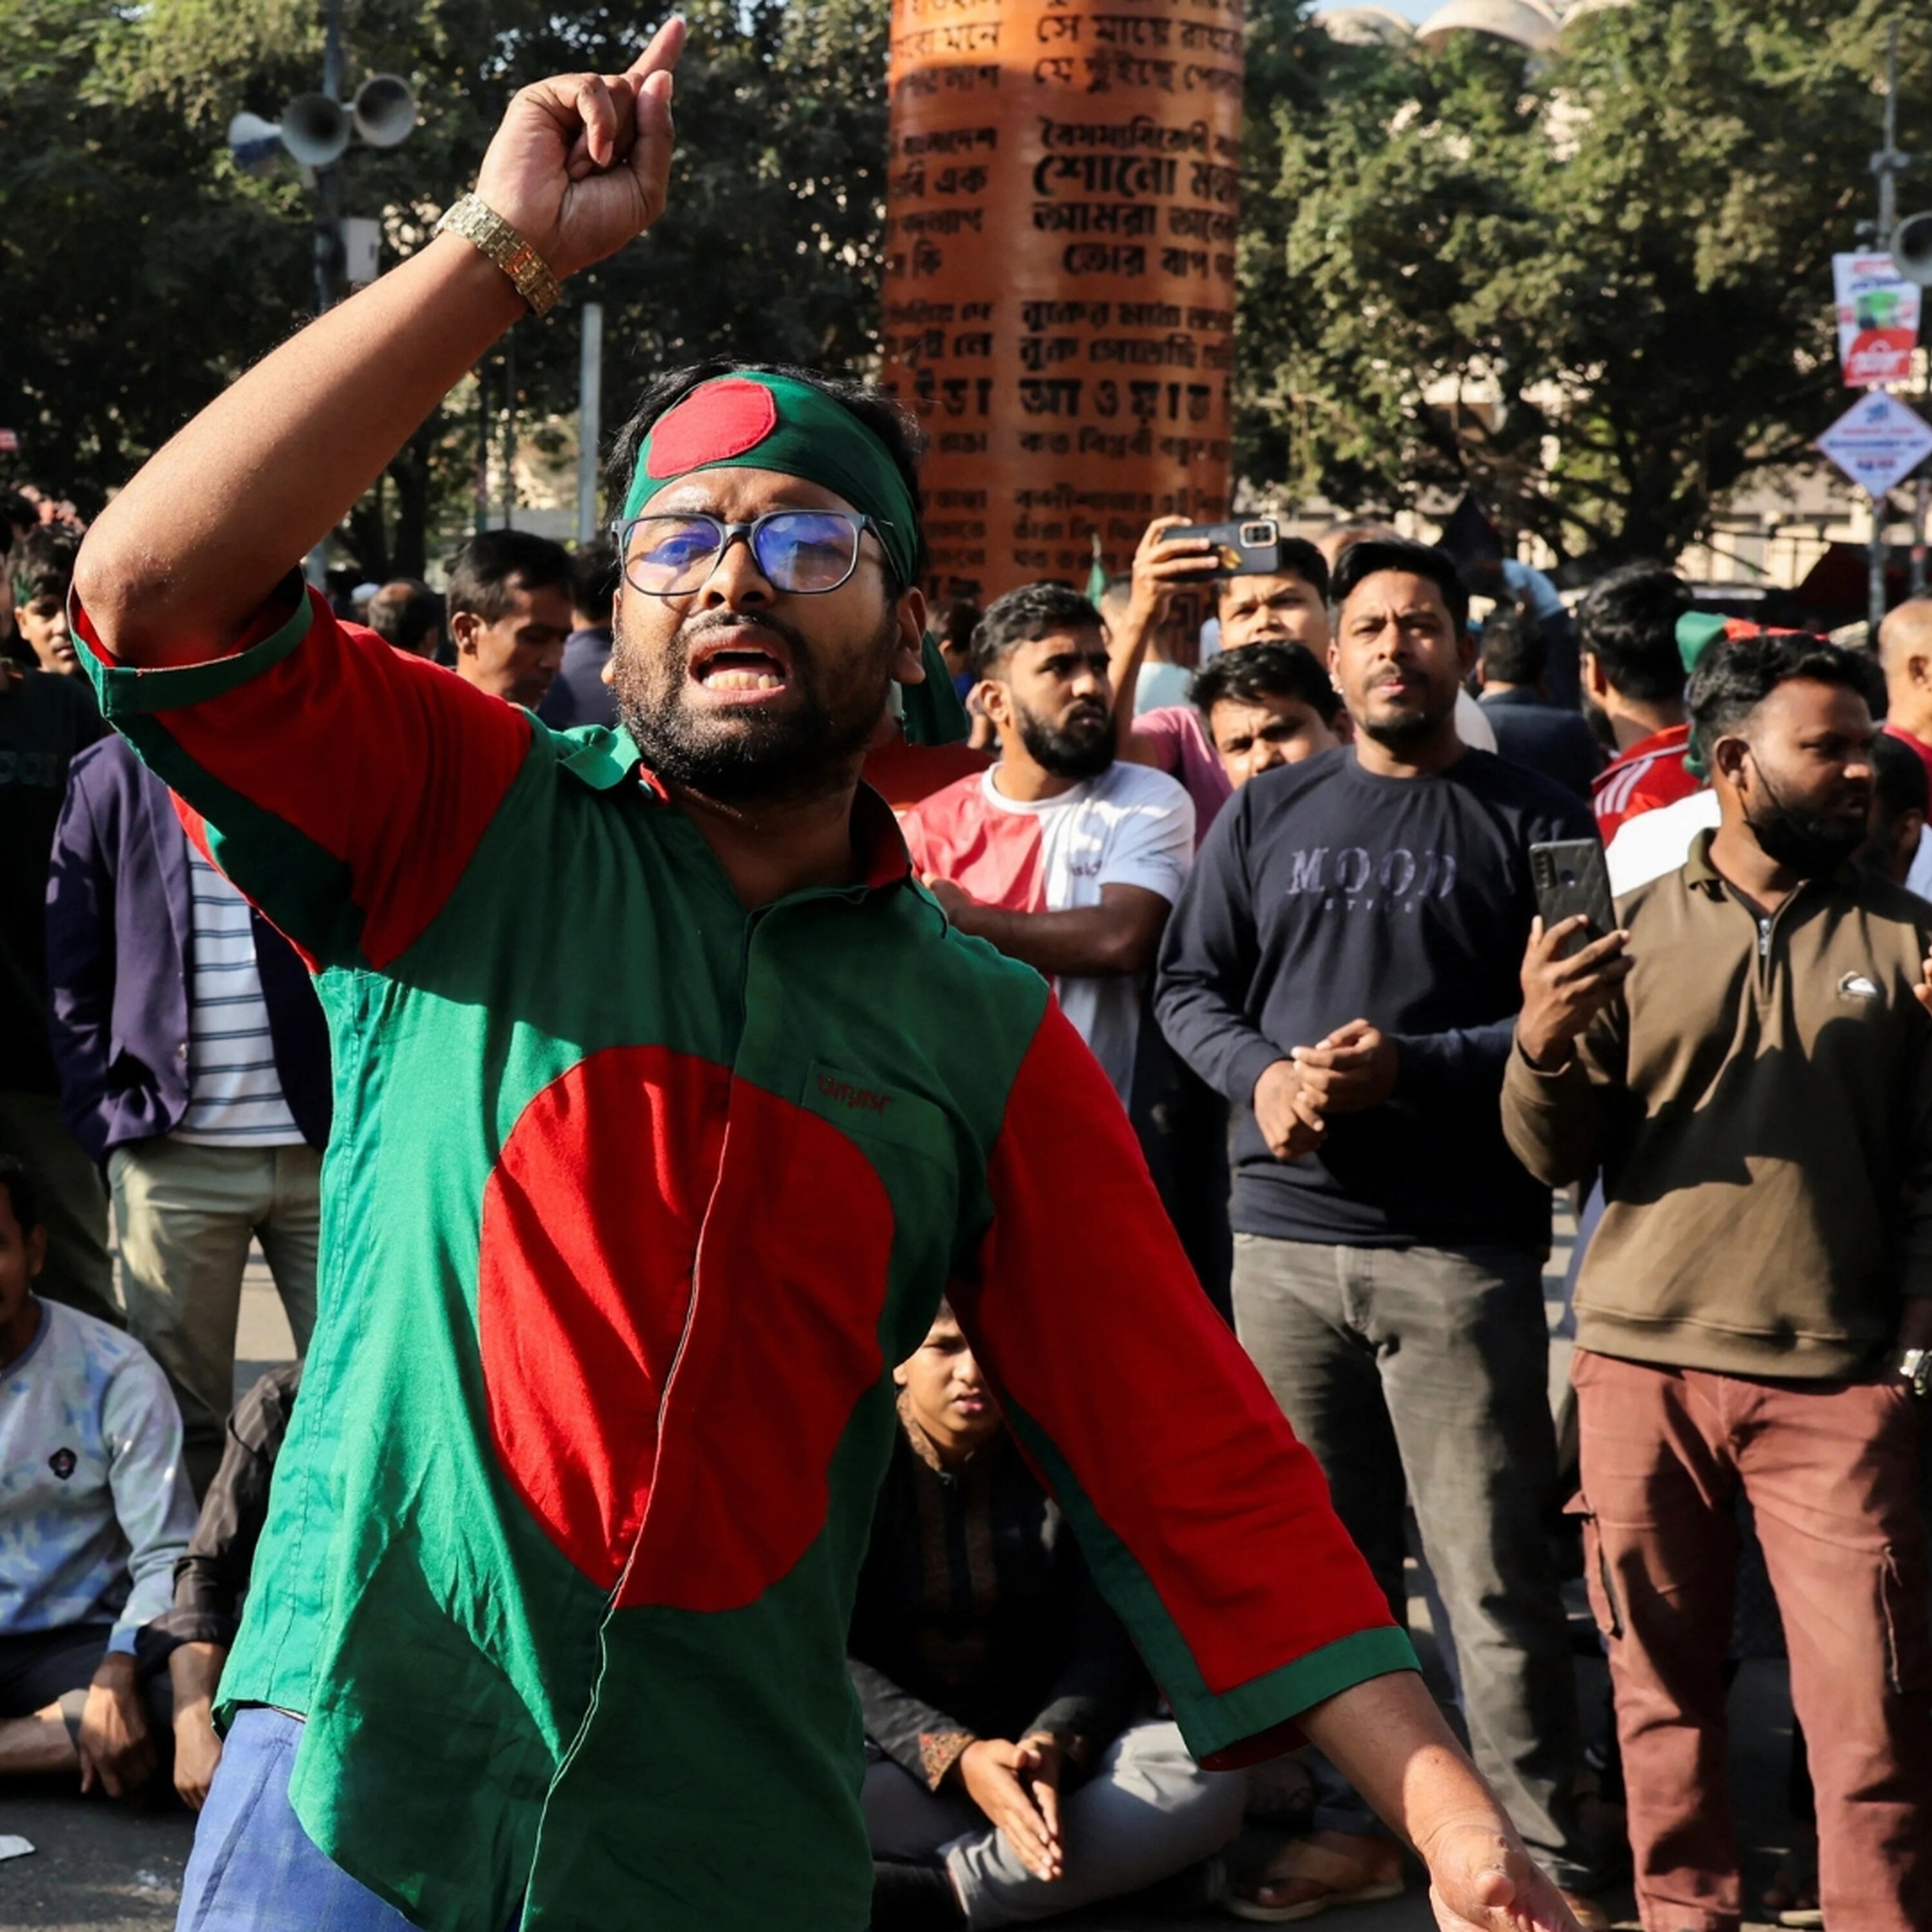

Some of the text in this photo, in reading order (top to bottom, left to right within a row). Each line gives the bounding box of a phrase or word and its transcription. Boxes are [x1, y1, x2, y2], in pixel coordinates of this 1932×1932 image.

[1033, 154, 1177, 198] শোনো
[1032, 202, 1157, 238] আমরা
[1286, 846, 1456, 898] MOOD
